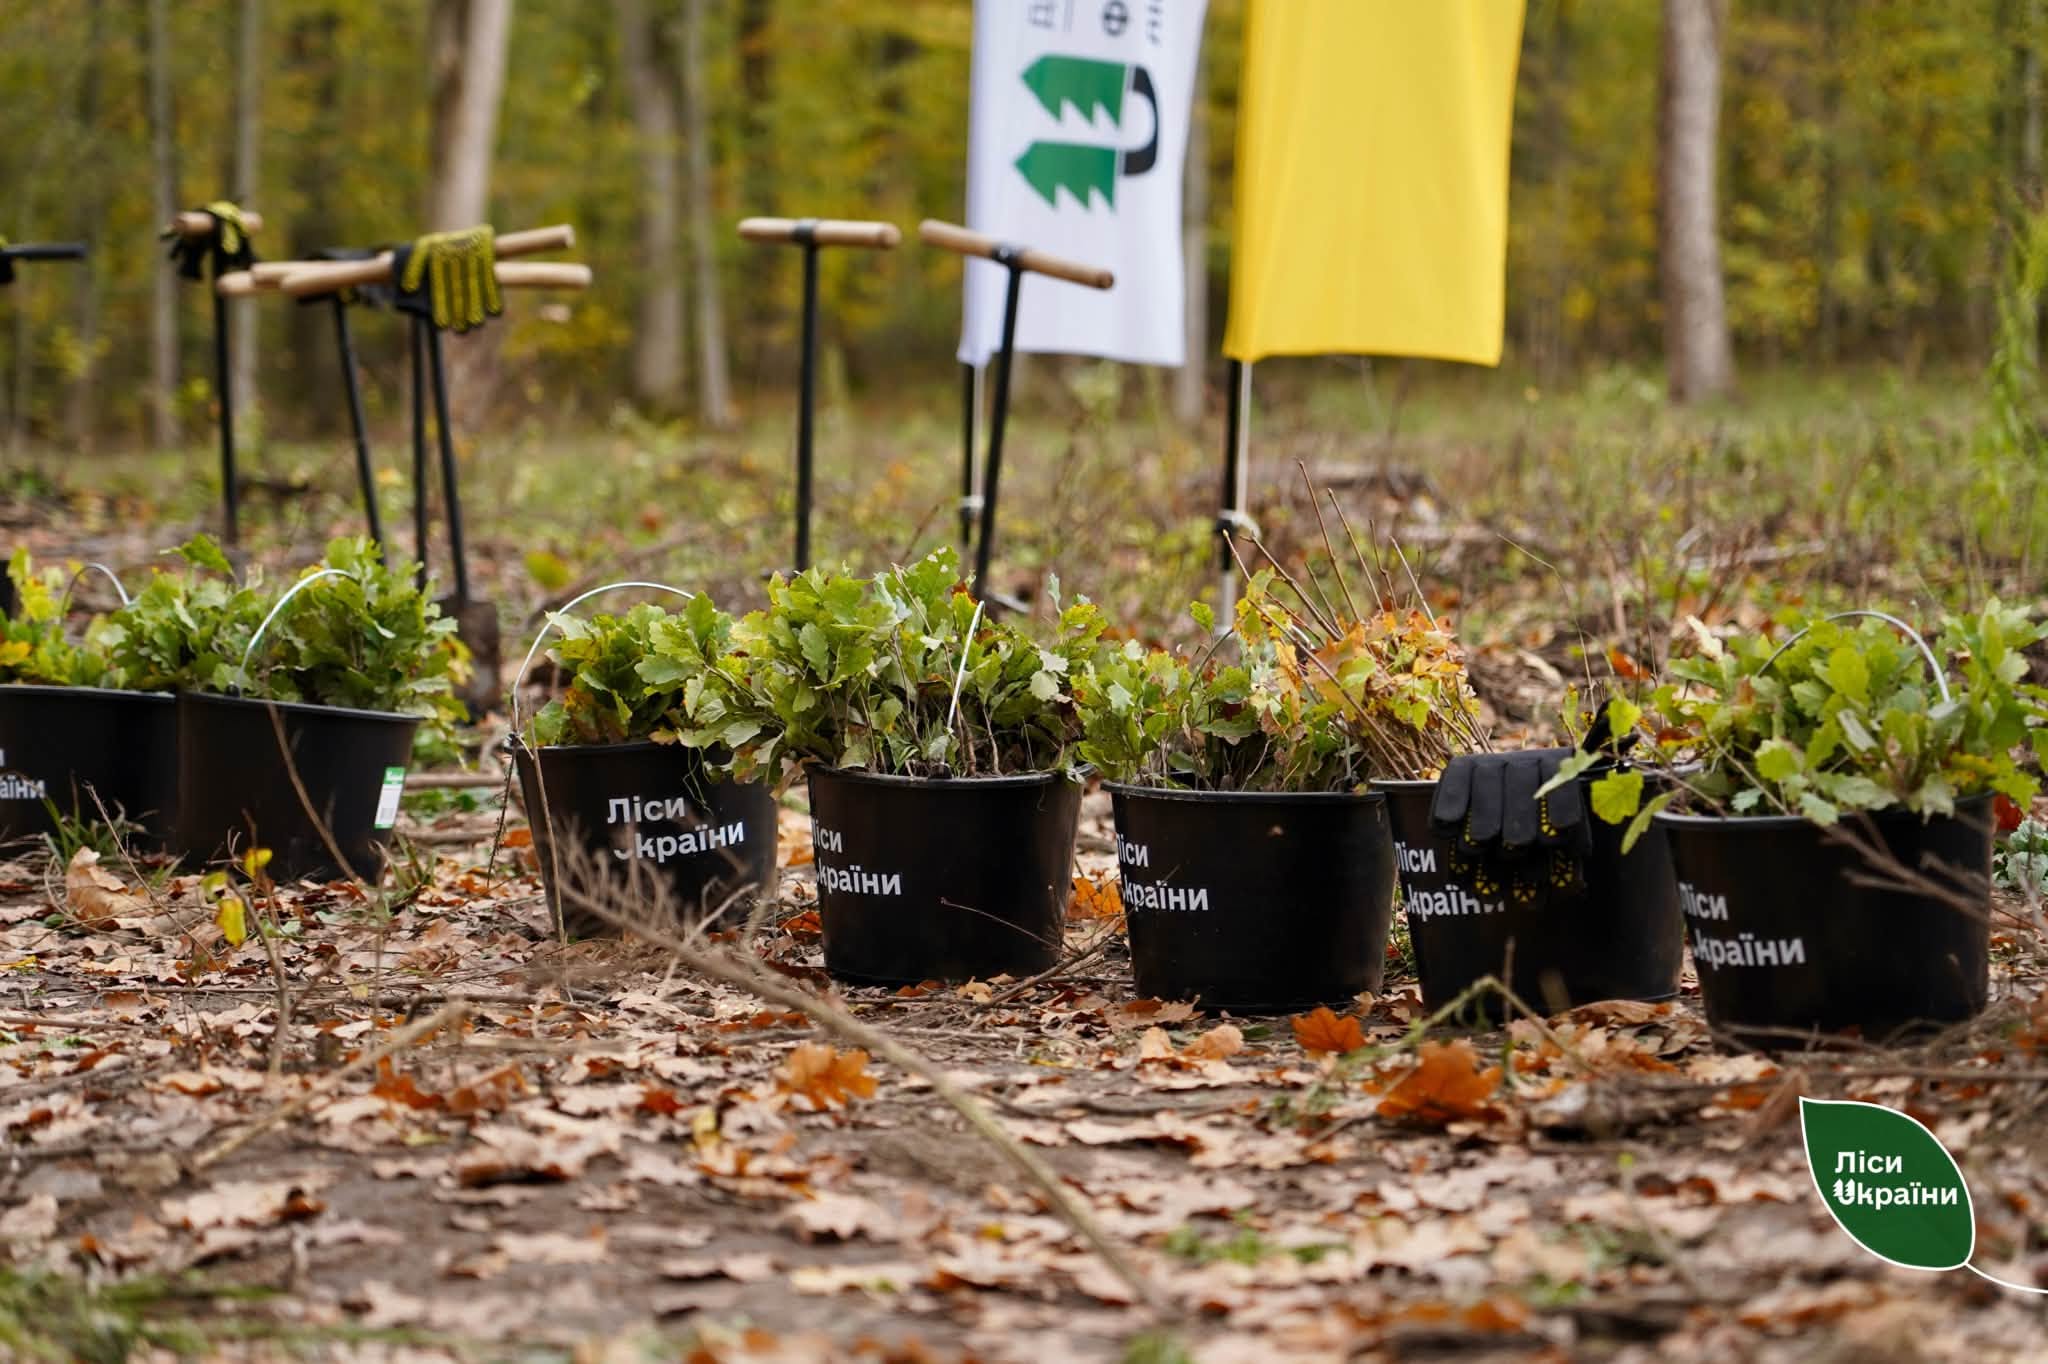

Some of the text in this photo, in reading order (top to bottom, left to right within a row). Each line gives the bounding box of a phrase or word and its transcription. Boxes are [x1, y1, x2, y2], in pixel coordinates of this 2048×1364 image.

[607, 795, 686, 824] Ліси
[816, 857, 902, 896] країни
[1122, 873, 1209, 912] країни
[1405, 883, 1505, 922] країн
[1693, 929, 1806, 971] країни
